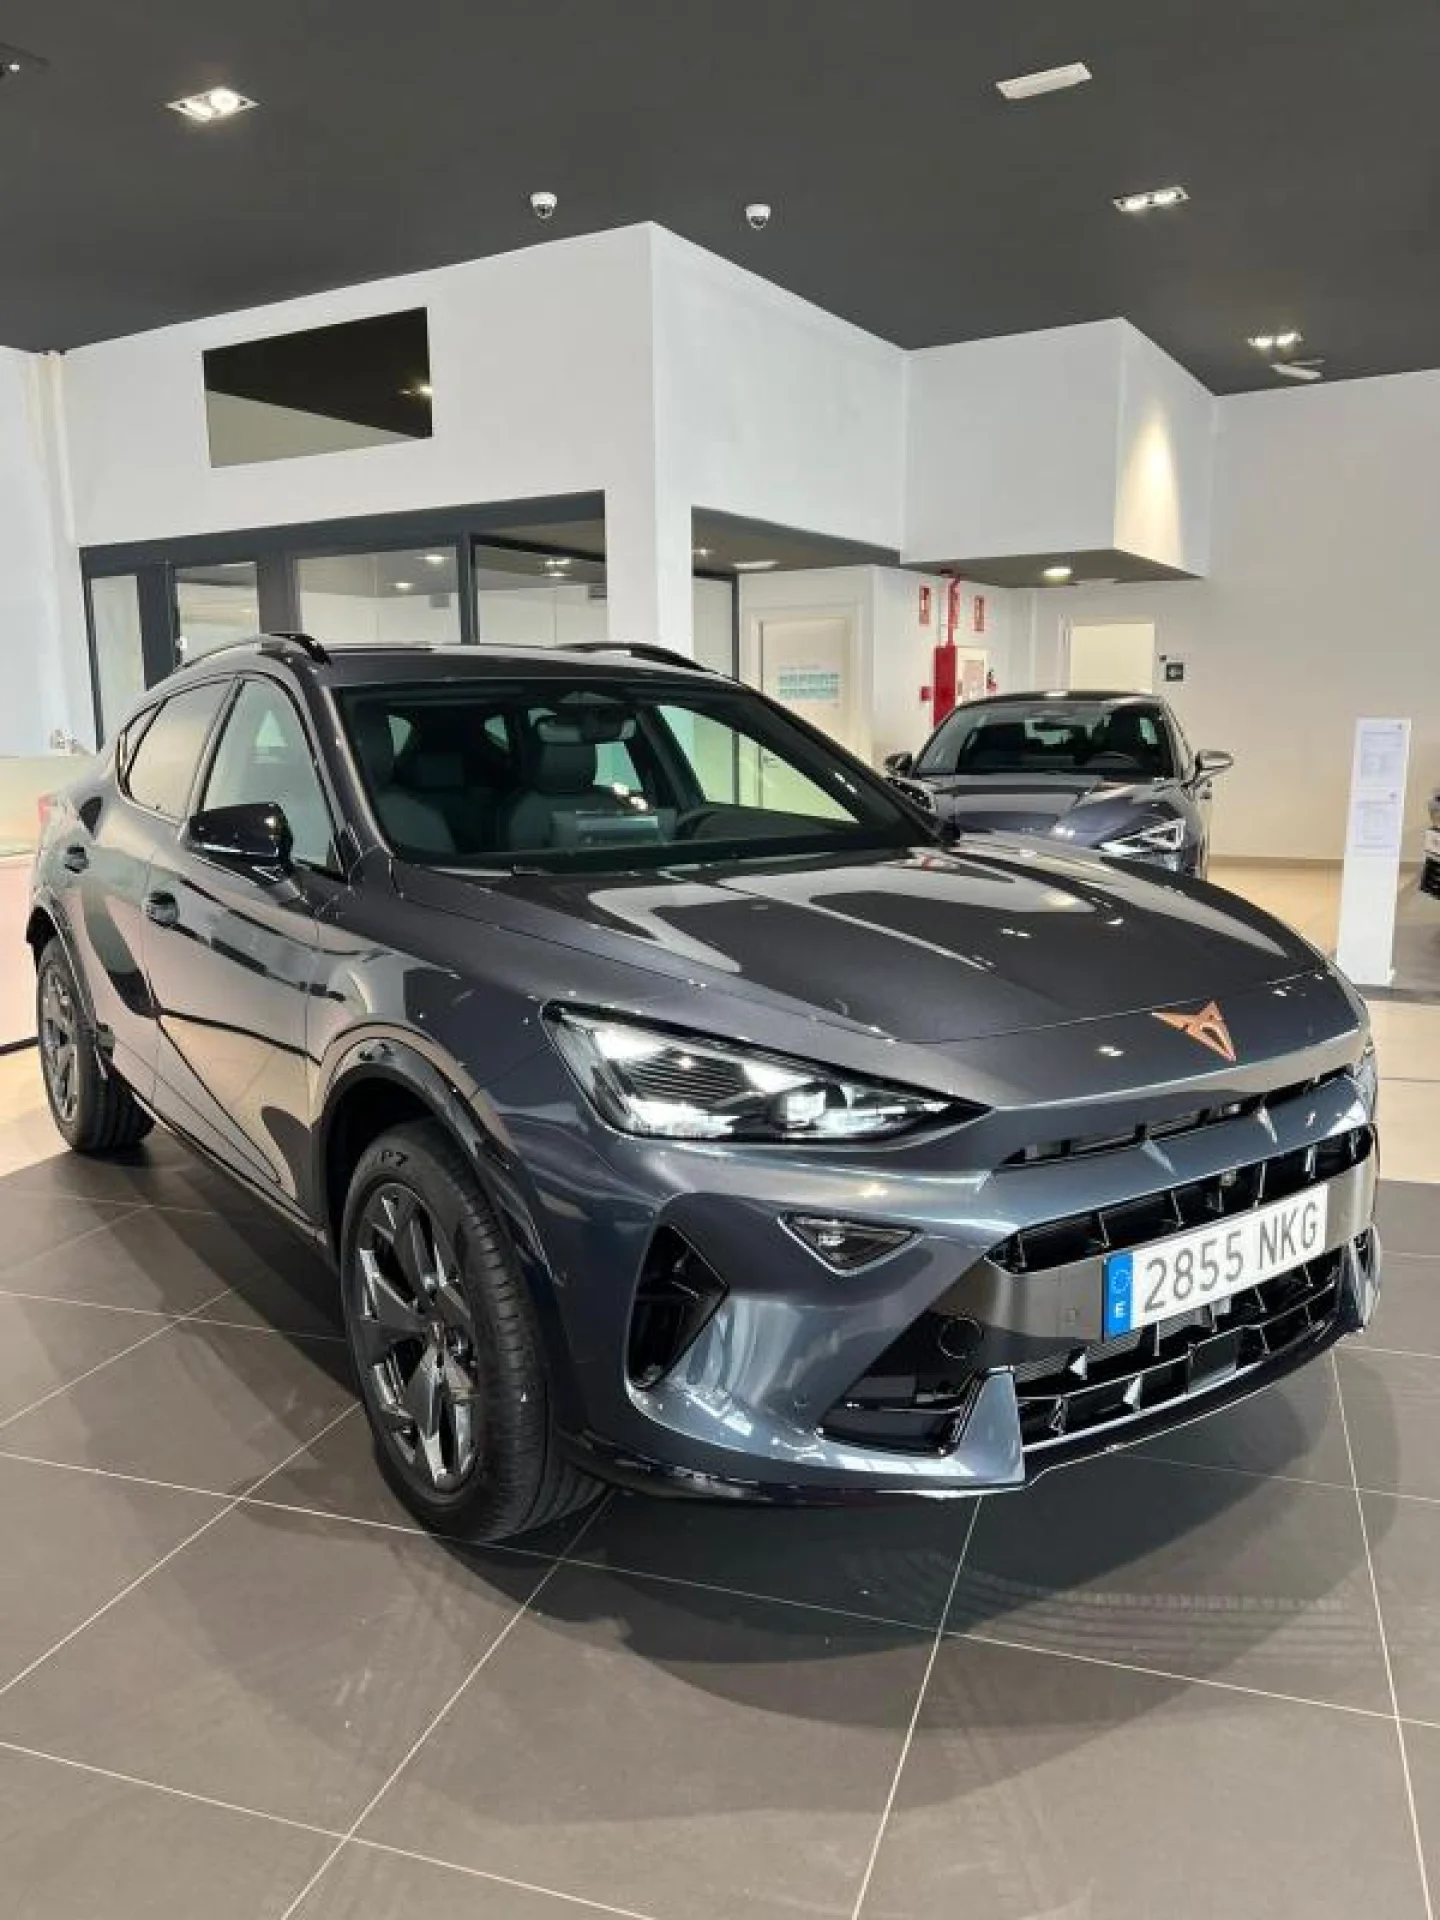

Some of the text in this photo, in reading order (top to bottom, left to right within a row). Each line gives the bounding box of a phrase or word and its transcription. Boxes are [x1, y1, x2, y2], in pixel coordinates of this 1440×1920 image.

[1144, 1201, 1317, 1313] 2855 NKG
[1115, 1302, 1125, 1319] E
